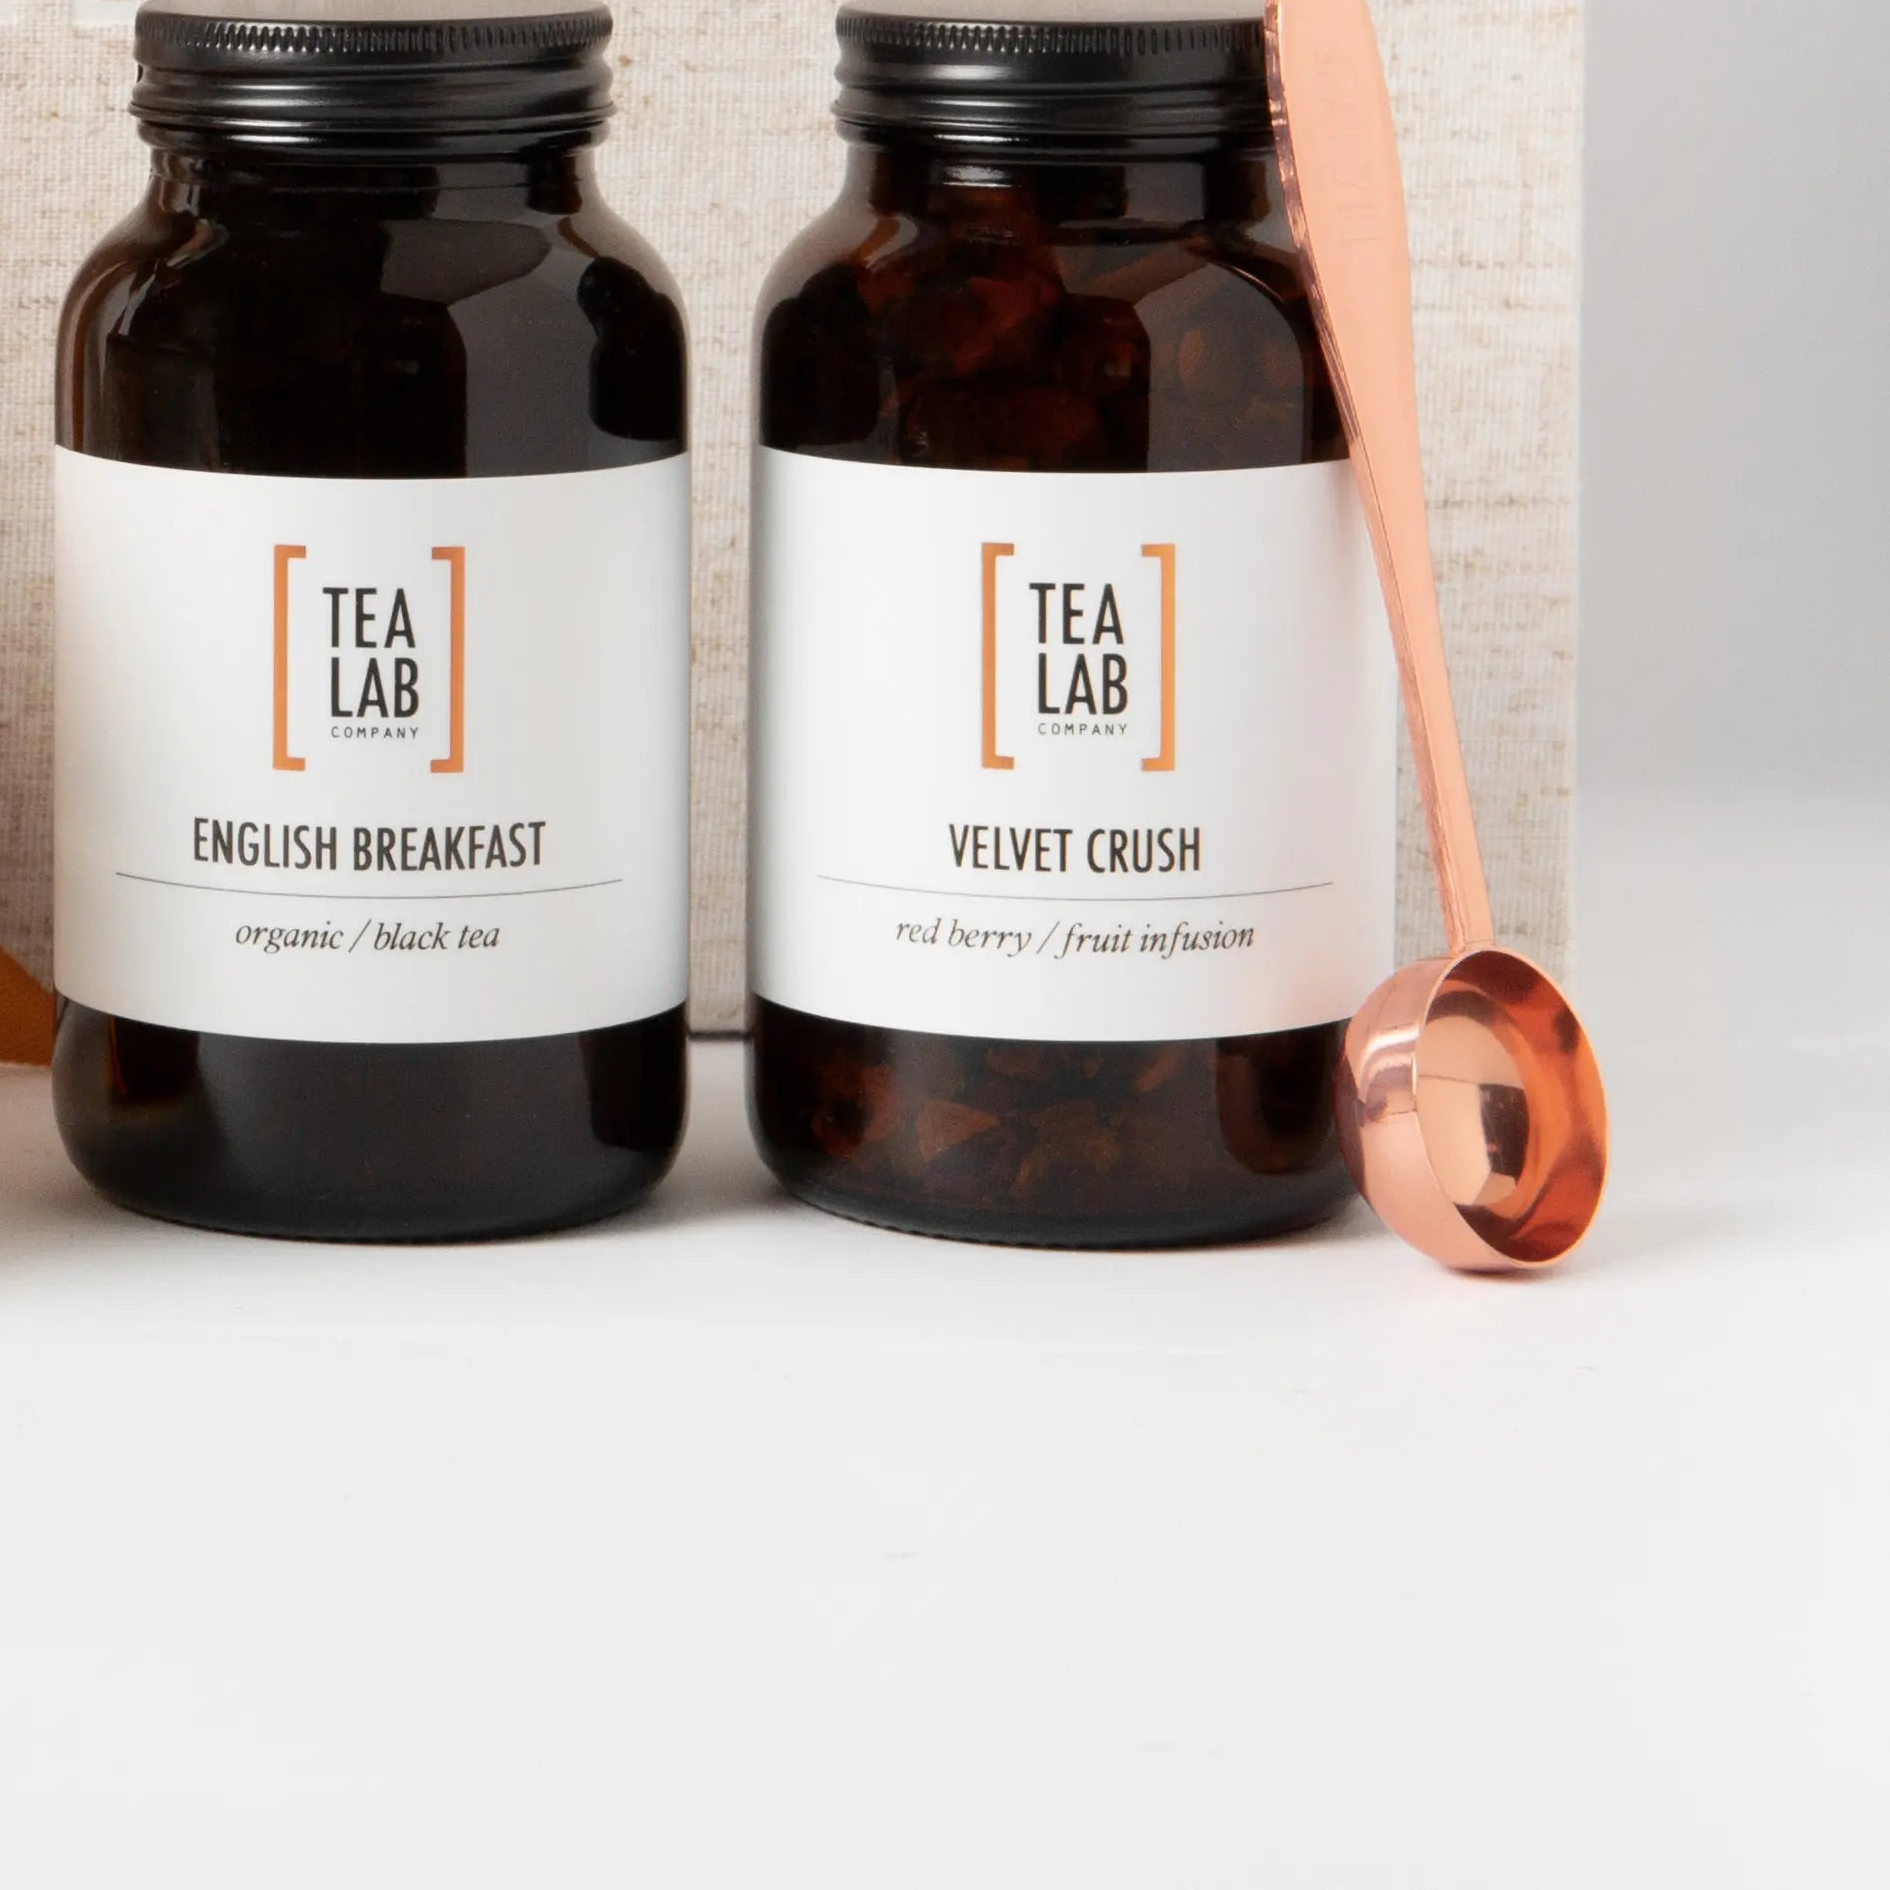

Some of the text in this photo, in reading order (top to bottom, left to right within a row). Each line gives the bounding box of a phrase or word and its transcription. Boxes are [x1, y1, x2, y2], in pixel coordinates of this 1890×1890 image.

[321, 586, 417, 649] TEA
[1028, 581, 1124, 645] TEA
[330, 657, 420, 719] LAB
[1037, 652, 1128, 716] LAB
[331, 725, 419, 739] COMPANY
[1038, 722, 1127, 736] COMPANY
[193, 817, 547, 872] ENGLISH BREAKFAST
[948, 824, 1200, 874] VELVET CRUSH
[235, 920, 344, 954] organic
[373, 921, 451, 951] black
[457, 925, 501, 950] tea
[896, 917, 942, 945] red
[947, 918, 1033, 958] berry
[1053, 922, 1133, 960] fruit
[1139, 921, 1255, 960] infusion
